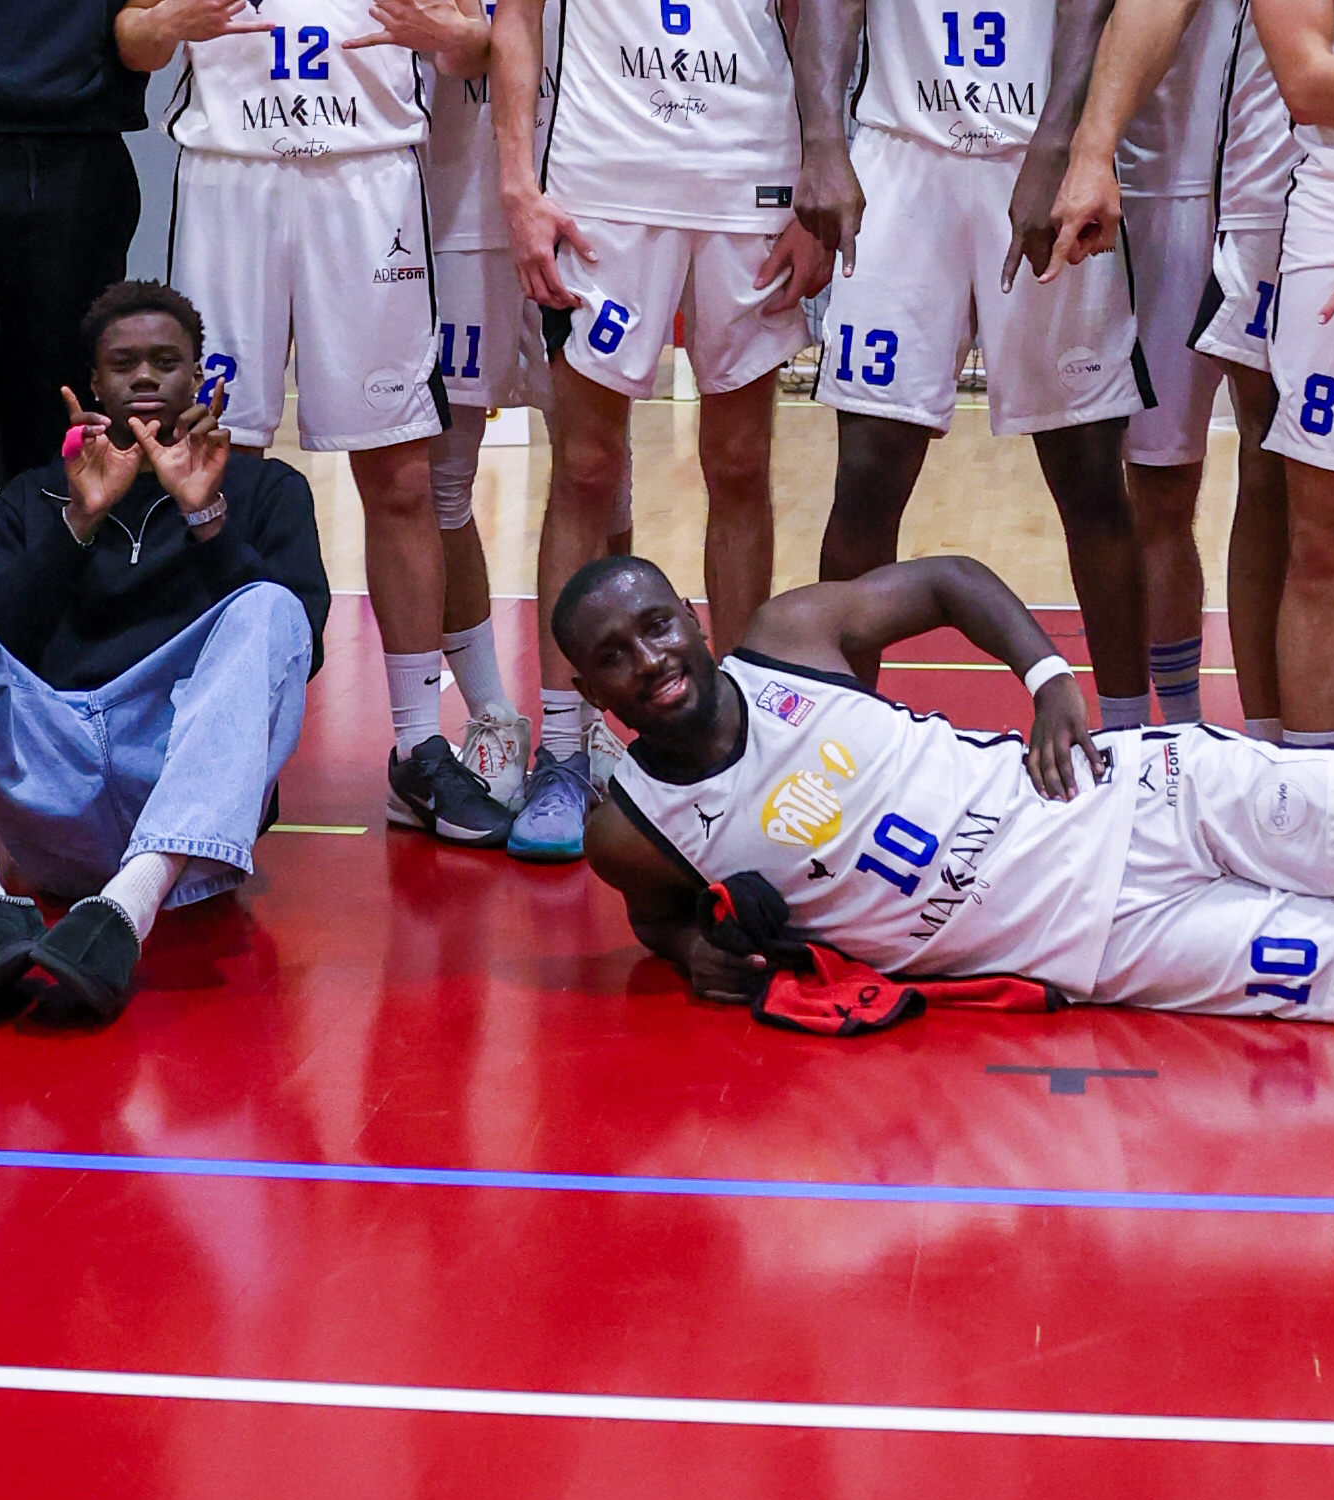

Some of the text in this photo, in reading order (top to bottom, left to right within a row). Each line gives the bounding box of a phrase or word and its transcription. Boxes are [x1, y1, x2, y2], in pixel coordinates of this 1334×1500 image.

[270, 25, 329, 80] 12
[942, 11, 1006, 67] 13
[373, 267, 425, 283] ADEcom
[440, 322, 481, 378] 11
[588, 298, 630, 355] 6
[835, 323, 898, 386] 13
[856, 812, 939, 898] 10
[1244, 935, 1319, 1005] 10
